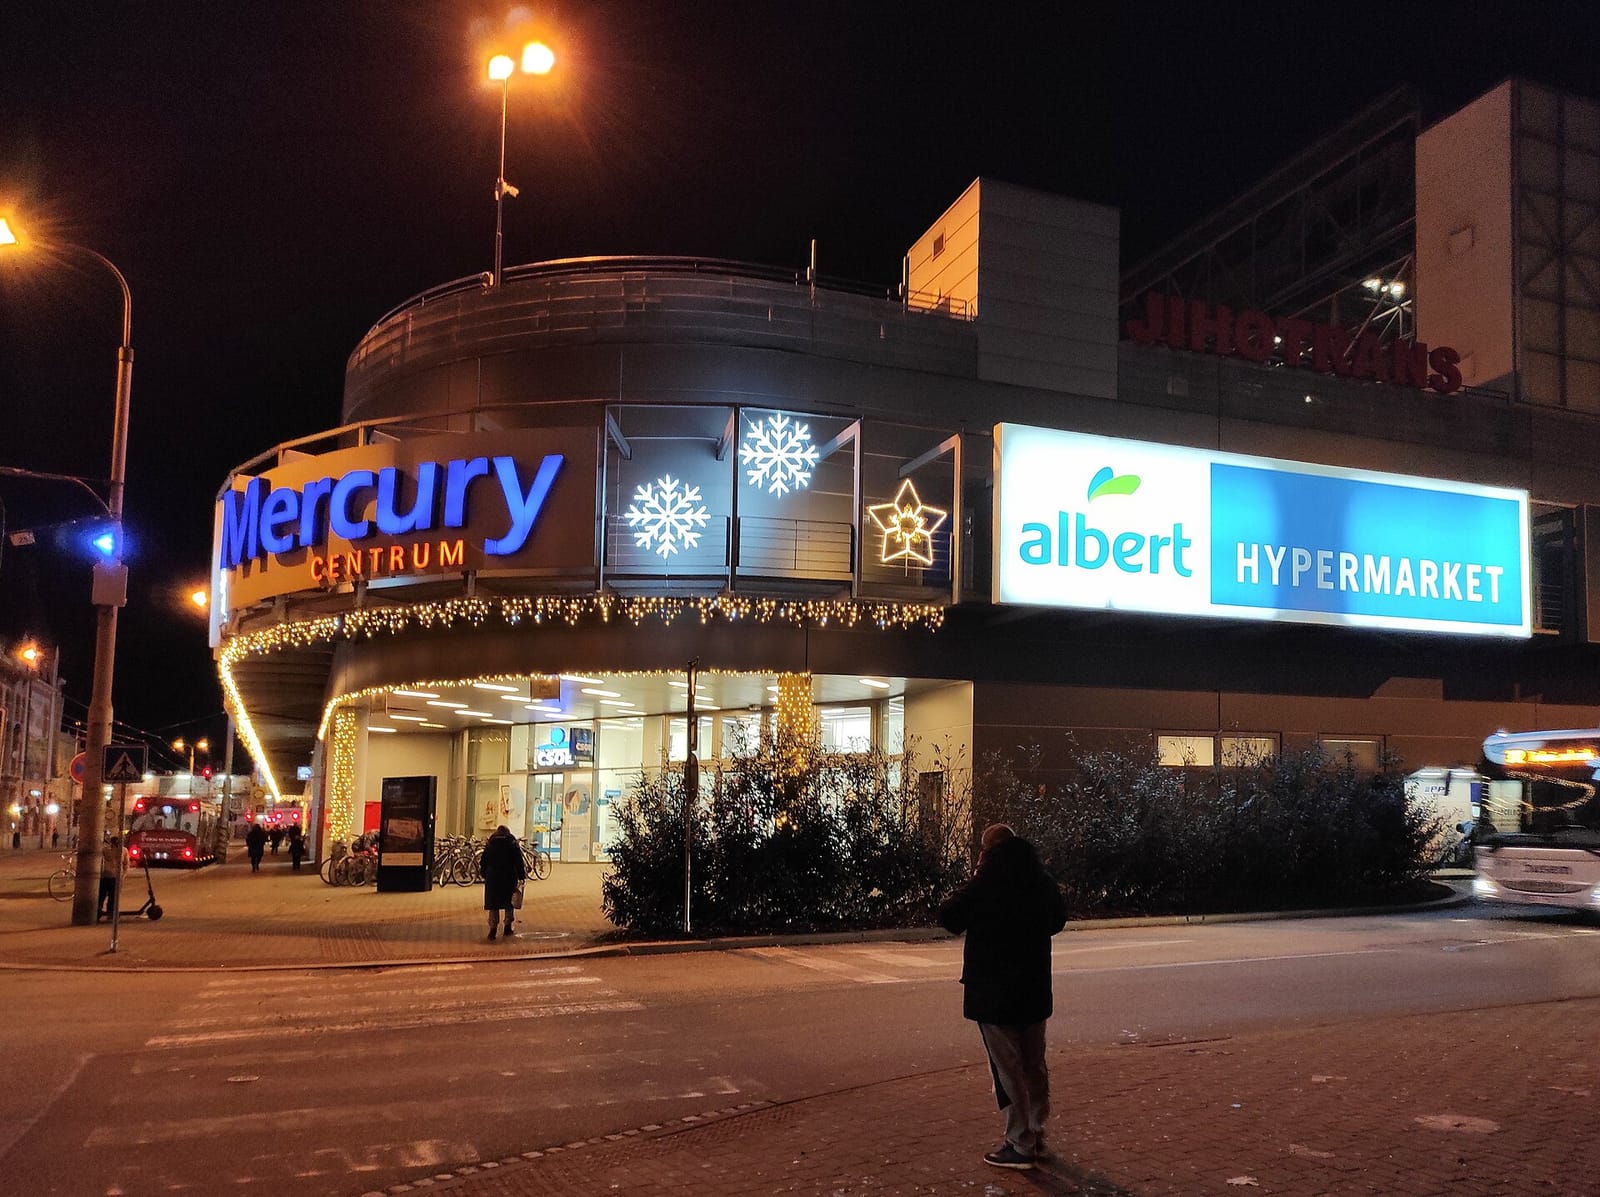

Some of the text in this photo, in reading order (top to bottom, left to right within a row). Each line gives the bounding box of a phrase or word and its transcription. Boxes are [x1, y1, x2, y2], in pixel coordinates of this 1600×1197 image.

[1127, 291, 1462, 393] JIHOTRANS
[220, 454, 564, 570] Mercury
[1019, 510, 1192, 577] albert
[311, 539, 465, 581] CENTRUM
[1236, 541, 1504, 604] HYPERMARKET
